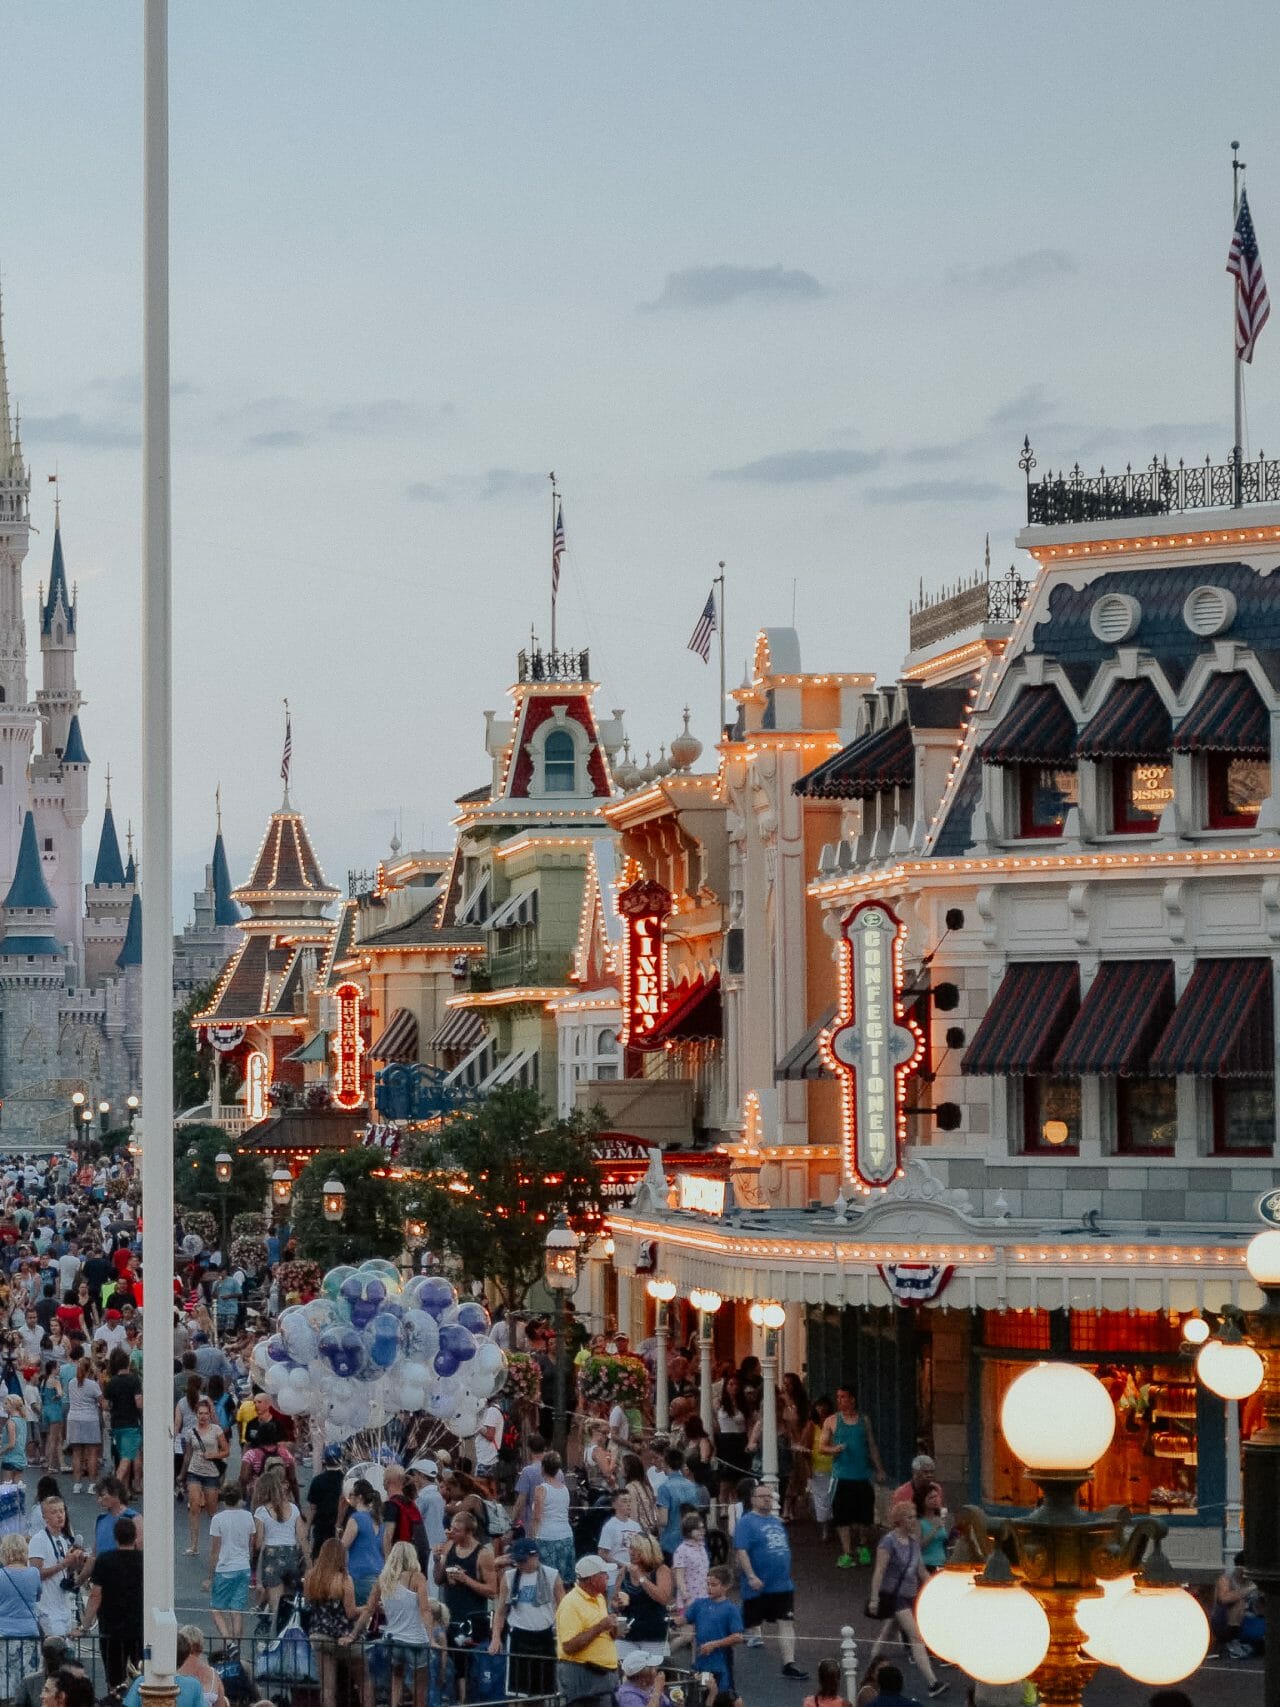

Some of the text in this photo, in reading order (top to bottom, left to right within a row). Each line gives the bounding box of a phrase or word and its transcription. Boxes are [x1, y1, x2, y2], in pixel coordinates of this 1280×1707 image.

[635, 916, 659, 1034] CINEMA
[343, 999, 355, 1091] CRYSTAL ARTS
[864, 930, 886, 1168] CONFECTIONERY
[591, 1145, 649, 1159] NEMA
